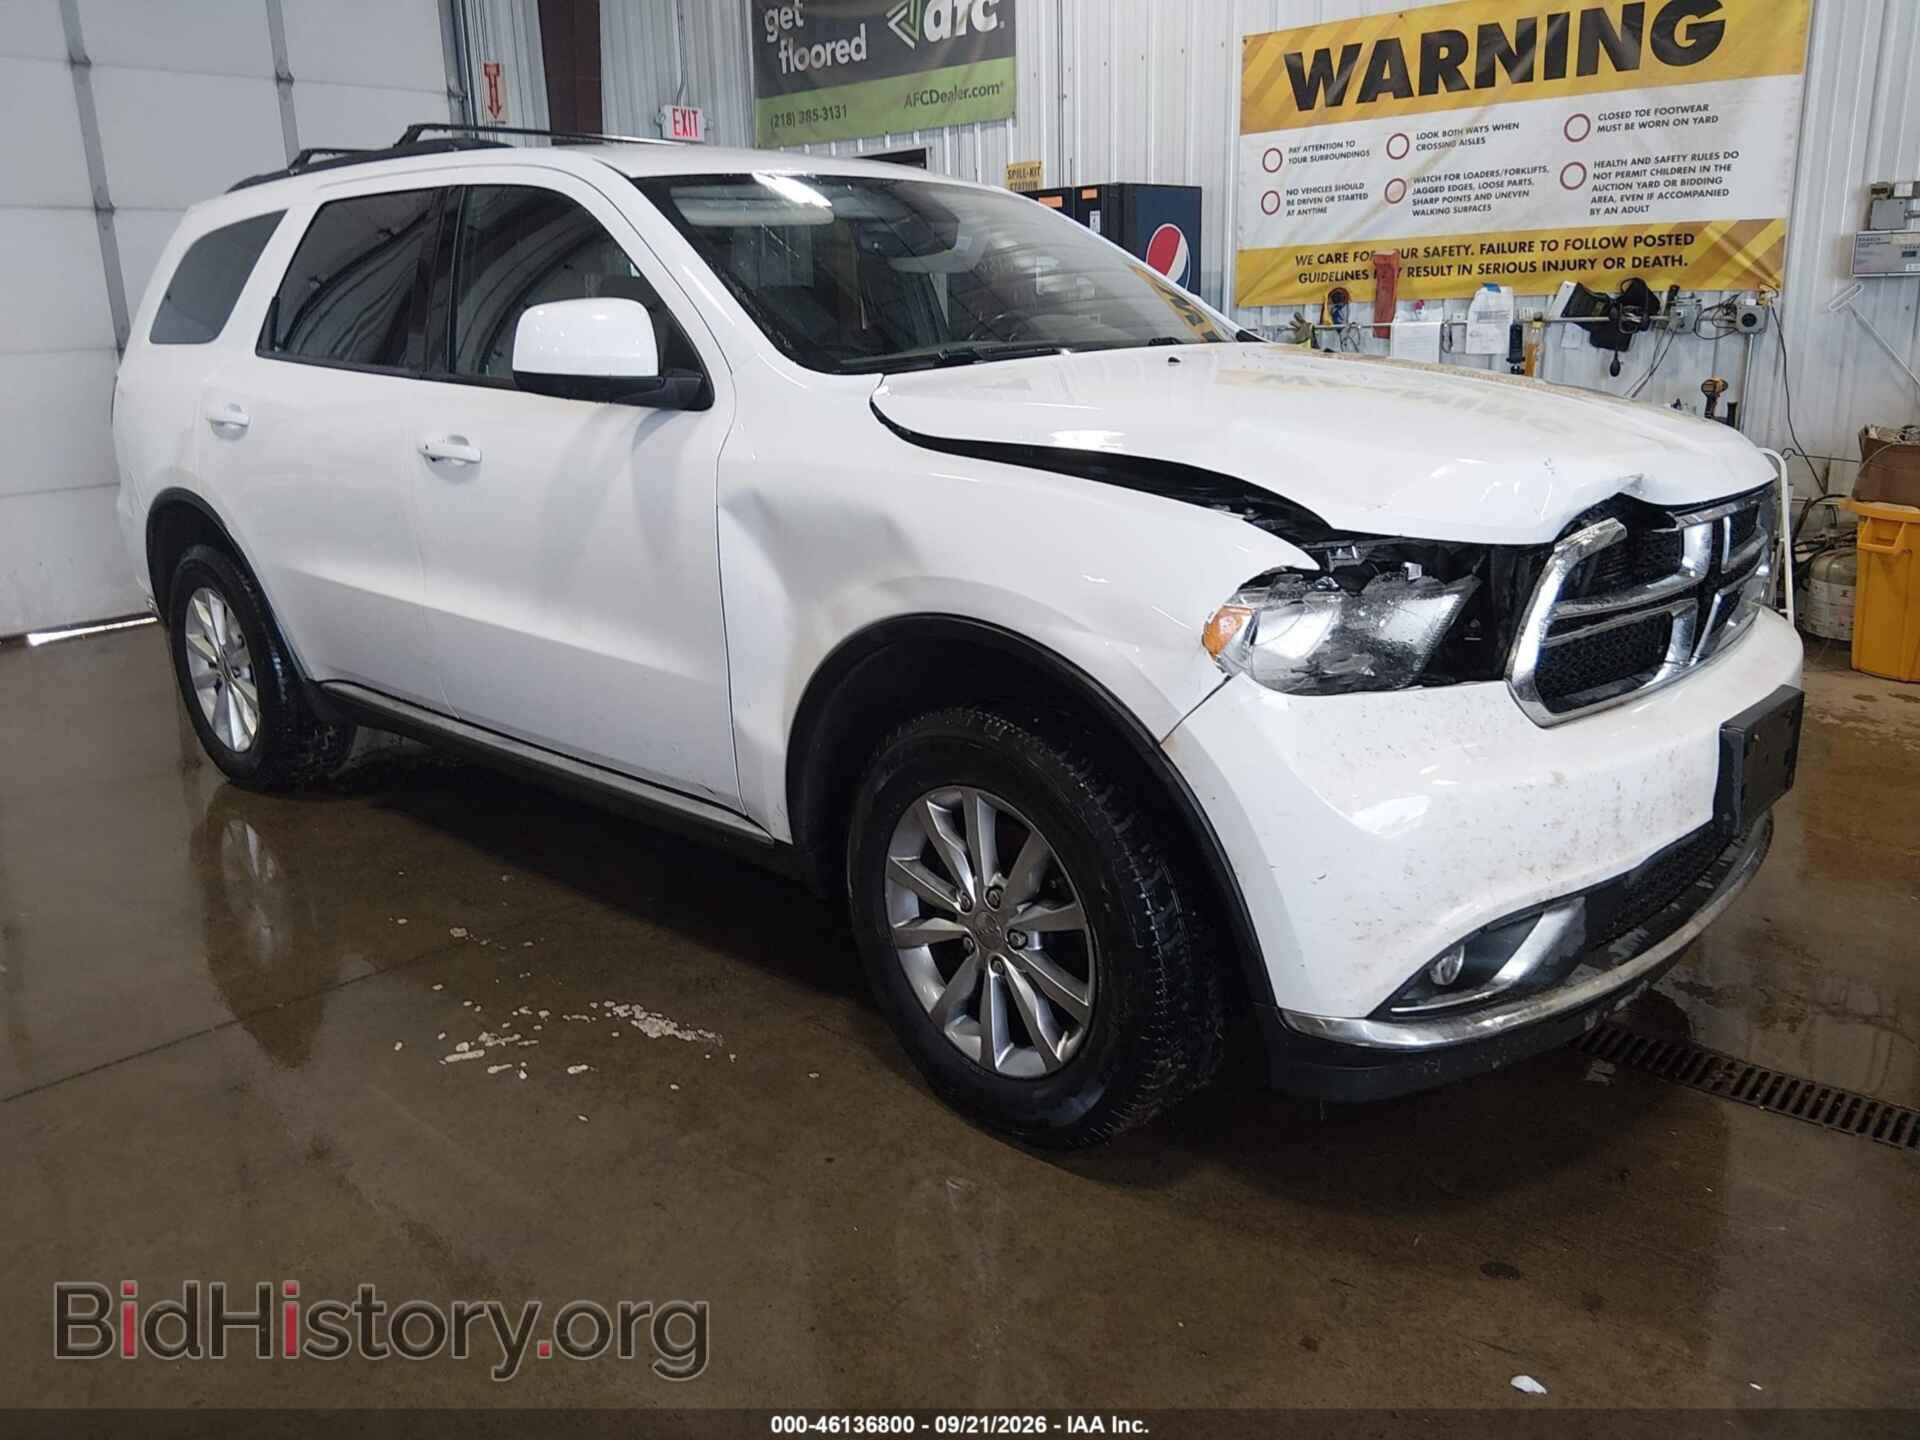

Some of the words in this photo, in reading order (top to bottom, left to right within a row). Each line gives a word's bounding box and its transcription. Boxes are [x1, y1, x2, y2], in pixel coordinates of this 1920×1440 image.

[764, 0, 804, 43] get
[778, 22, 867, 75] floored
[1284, 0, 1726, 112] WARNING
[769, 112, 796, 129] (218)
[1598, 111, 1631, 121] CLOSED
[1634, 108, 1651, 117] TOE
[1654, 104, 1709, 115] FOOTWEAR
[672, 107, 698, 137] EXIT
[1597, 123, 1622, 133] MUST
[1624, 122, 1635, 130] BE
[1638, 119, 1670, 129] WORN
[1673, 118, 1689, 127] ON
[1693, 115, 1719, 125] YARD
[1416, 131, 1439, 141] LOOK
[1442, 128, 1463, 138] BOTH
[1465, 125, 1489, 135] WAYS
[1491, 122, 1520, 132] WHEN
[1303, 141, 1344, 152] ATTENTION
[1346, 140, 1356, 148] TO
[1416, 139, 1457, 151] CROSSING
[1458, 137, 1486, 146] AISLES
[1288, 156, 1308, 165] YOUR
[1310, 150, 1370, 163] SURROUNDINGS
[1594, 159, 1628, 169] HEALTH
[1630, 156, 1651, 166] AND
[1654, 154, 1688, 165] SAFETY
[1690, 152, 1720, 161] RULES
[1723, 150, 1740, 159] DO
[1413, 174, 1442, 184] WATCH
[1444, 173, 1460, 181] FOR
[1593, 172, 1612, 180] NOT
[1615, 169, 1648, 178] PERMIT
[1650, 166, 1696, 176] CHILDREN
[1699, 164, 1711, 173] IN
[1714, 163, 1732, 172] THE
[1286, 188, 1299, 196] NO
[1301, 185, 1333, 195] VEHICLES
[1334, 182, 1365, 192] SHOULD
[1412, 185, 1445, 195] JAGGED
[1478, 180, 1505, 189] LOOSE
[1592, 182, 1633, 192] AUCTION
[1637, 180, 1661, 189] YARD
[1663, 178, 1678, 187] OR
[1680, 176, 1723, 186] BIDDING
[1286, 199, 1295, 207] BE
[1297, 196, 1323, 206] DRIVEN
[1325, 195, 1335, 203] OR
[1337, 193, 1369, 202] STARTED
[1412, 196, 1439, 205] SHARP
[1442, 193, 1471, 203] POINTS
[1474, 192, 1493, 201] AND
[1495, 190, 1530, 199] UNEVEN
[1590, 195, 1617, 204] AREA,
[1620, 193, 1644, 202] EVEN
[1647, 192, 1655, 200] IF
[1657, 188, 1730, 200] ACCOMPANIED
[1286, 209, 1296, 217] AT
[1297, 207, 1327, 216] ANYTIME
[1412, 206, 1450, 217] WALKING
[1453, 203, 1492, 214] SURFACES
[1589, 207, 1601, 216] BY
[1604, 206, 1618, 215] AN
[1621, 204, 1650, 214] ADULT
[1296, 254, 1313, 266] WE
[1317, 252, 1349, 265] CARE
[1423, 243, 1475, 260] SAFETY.
[1480, 240, 1535, 255] FAILURE
[1541, 239, 1559, 251] TO
[1564, 236, 1628, 251] FOLLOW
[1633, 233, 1695, 248] POSTED
[1299, 269, 1369, 284] GUIDELINES
[1408, 264, 1453, 278] RESULT
[1458, 264, 1472, 276] IN
[1477, 260, 1537, 275] SERIOUS
[1542, 258, 1598, 272] INJURY
[1603, 257, 1626, 270] OR
[1632, 254, 1688, 268] DEATH.
